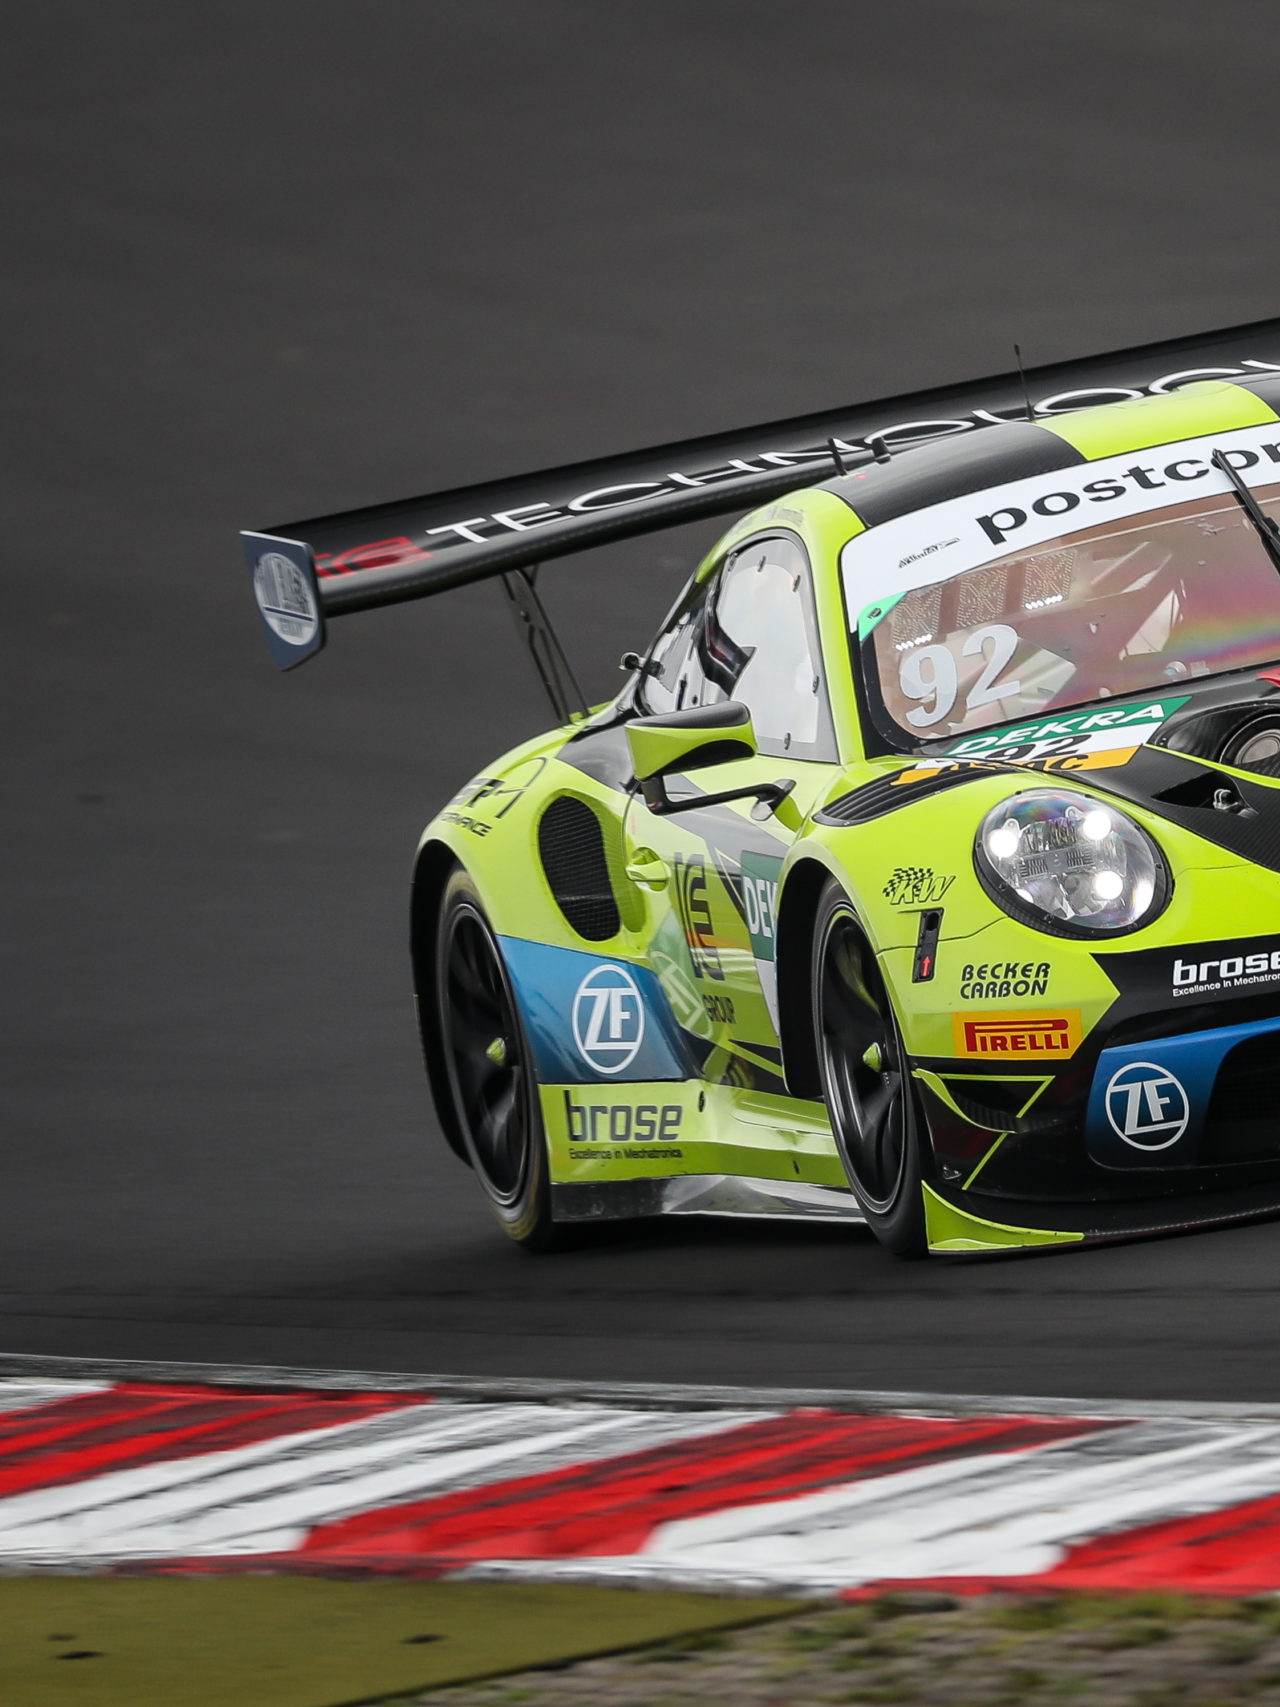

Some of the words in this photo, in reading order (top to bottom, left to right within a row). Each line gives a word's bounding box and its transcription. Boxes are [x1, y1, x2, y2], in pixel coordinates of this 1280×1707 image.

[901, 624, 1021, 728] 92
[946, 704, 1166, 756] DEKRA
[890, 875, 957, 905] KW
[960, 980, 1048, 999] CARBON
[961, 963, 1051, 981] BECKER
[1172, 982, 1221, 997] Excellence
[1223, 979, 1232, 988] in
[576, 987, 640, 1051] ZF
[964, 1018, 1069, 1052] PIRELLI
[563, 1089, 683, 1142] brose
[1109, 1075, 1185, 1136] ZF
